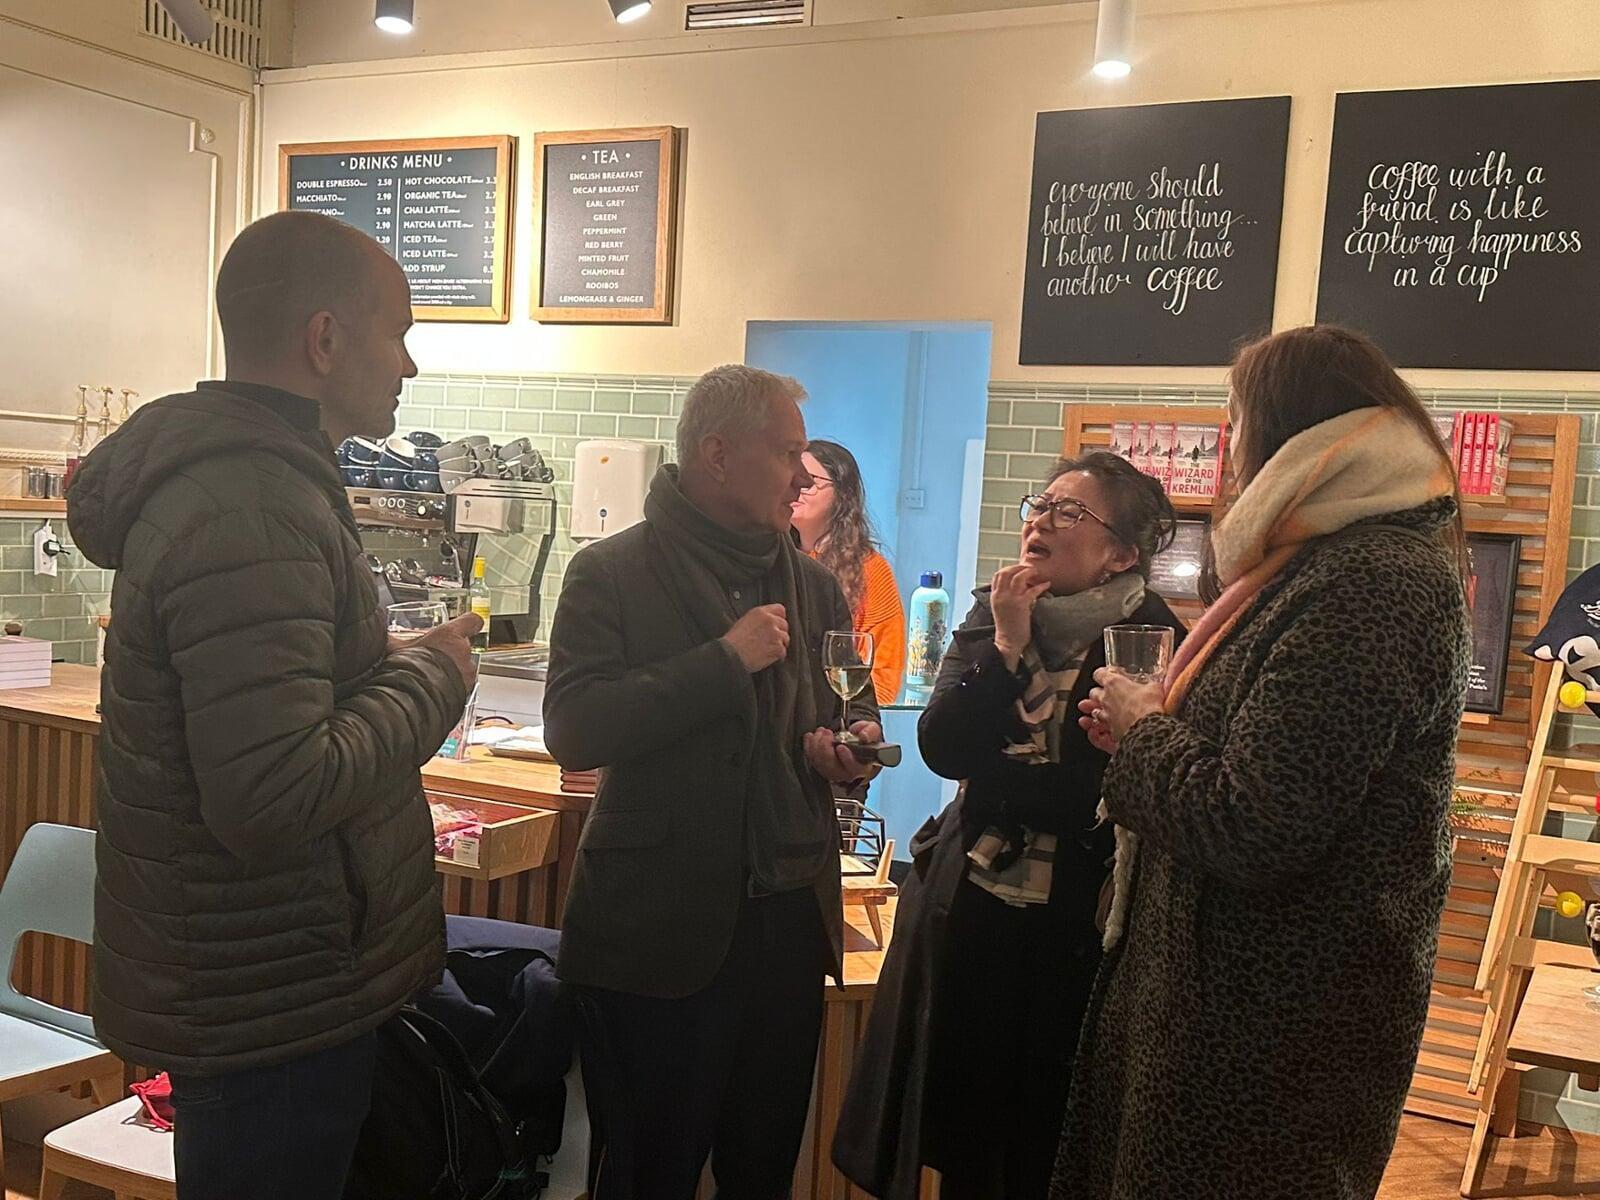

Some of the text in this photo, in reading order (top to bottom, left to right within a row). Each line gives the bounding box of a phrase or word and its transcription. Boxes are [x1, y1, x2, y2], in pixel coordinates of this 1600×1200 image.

[349, 153, 442, 170] DRINKS MENU
[592, 150, 619, 164] TEA
[424, 176, 472, 185] CHOCOLATE
[569, 171, 643, 181] ENGLISH BREAKFAST
[1368, 151, 1546, 201] coffee with a
[296, 180, 324, 189] DOUBLE
[326, 179, 360, 188] ESPRESSO
[377, 178, 393, 186] 2.50
[573, 185, 640, 194] DECAF BREAKFAST
[296, 194, 338, 203] MACCHIATO
[376, 193, 392, 201] 2.90
[404, 192, 440, 200] ORGANIC
[442, 191, 456, 199] TEA
[1049, 180, 1140, 217] everyone
[586, 200, 625, 208] EARL GREY
[1357, 185, 1549, 232] friend is like
[376, 207, 391, 215] 2.90
[404, 206, 423, 214] CHAI
[424, 205, 449, 214] LATTE
[403, 220, 436, 229] MATCHA
[437, 220, 462, 228] LATTE
[1040, 203, 1097, 237] believe
[1104, 203, 1124, 233] in
[583, 227, 627, 235] PEPPERMINT
[403, 235, 421, 243] ICED
[422, 235, 437, 243] TEA
[585, 241, 600, 249] RED
[1042, 227, 1235, 267] I believe I will have
[1344, 219, 1582, 272] capturing happiness
[402, 250, 421, 258] ICED
[422, 249, 447, 257] LATTE
[578, 254, 630, 262] MINTED FRUIT
[403, 264, 420, 272] ADD
[421, 264, 446, 272] SYRUP
[581, 268, 625, 276] CHAMOMILE
[1047, 265, 1132, 296] another
[1394, 254, 1499, 302] in a cup
[559, 295, 608, 303] LEMONGRASS
[1174, 468, 1214, 479] WIZARD
[1171, 484, 1214, 495] KREMLIN
